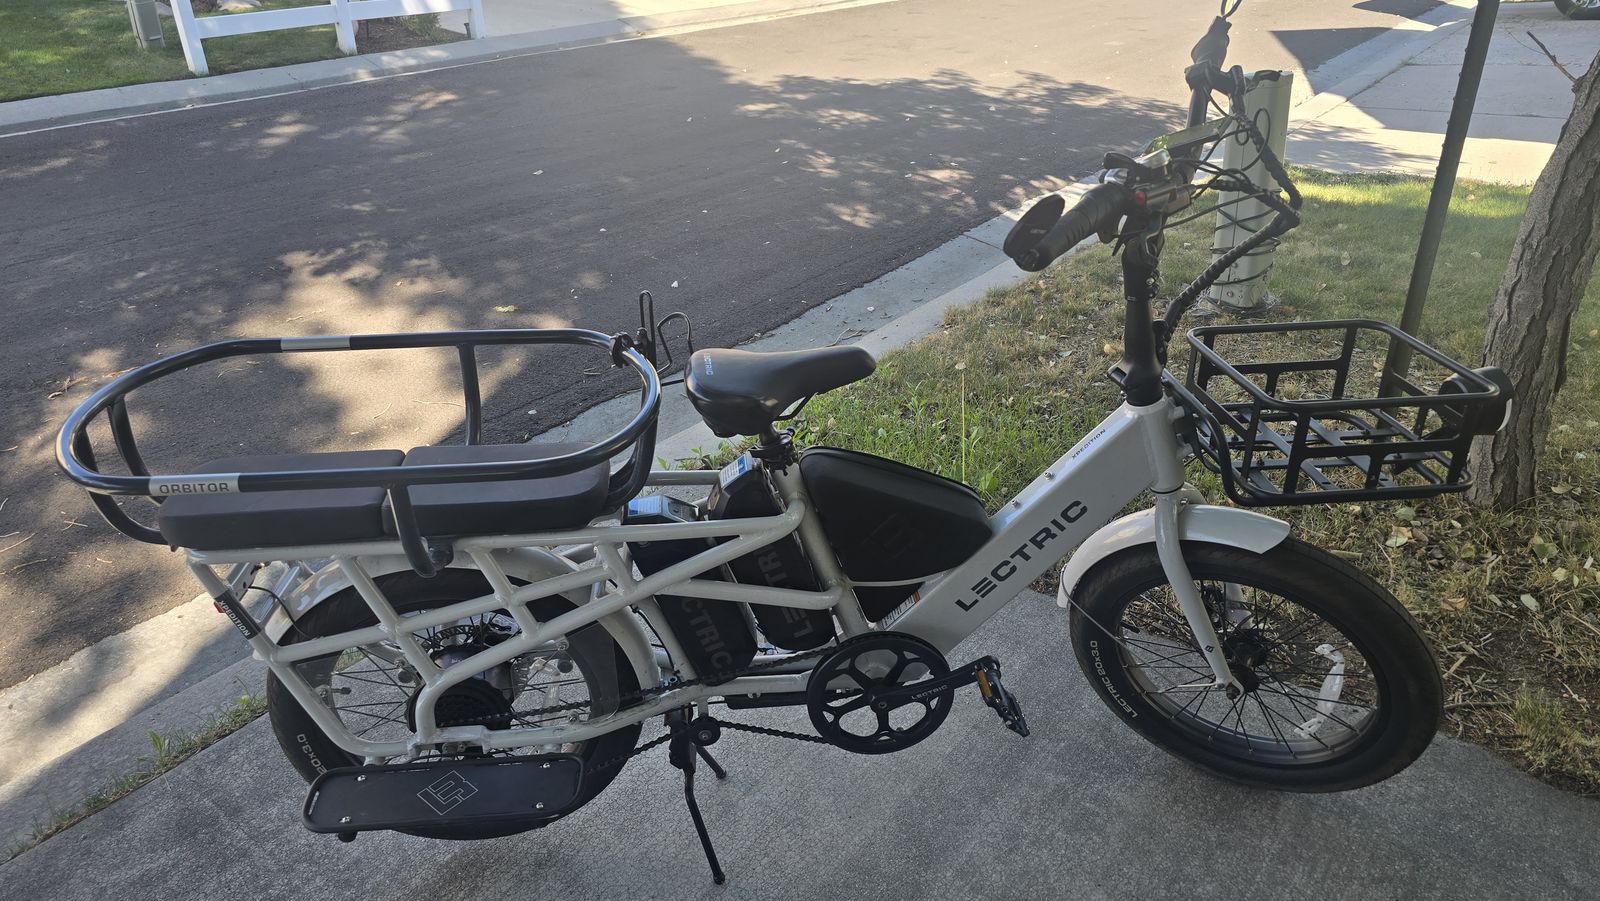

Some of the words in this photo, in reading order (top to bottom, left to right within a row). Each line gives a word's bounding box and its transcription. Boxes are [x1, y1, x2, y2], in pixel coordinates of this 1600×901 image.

[1072, 428, 1107, 460] XPEDITION
[160, 482, 229, 494] ORBITOR
[954, 500, 1089, 612] LECTRIC
[219, 600, 251, 637] XPEDITION
[681, 598, 732, 669] CTRIC
[1090, 640, 1106, 676] 20x3.0
[911, 684, 948, 700] LECTRIC
[1101, 676, 1138, 718] LECTRIC
